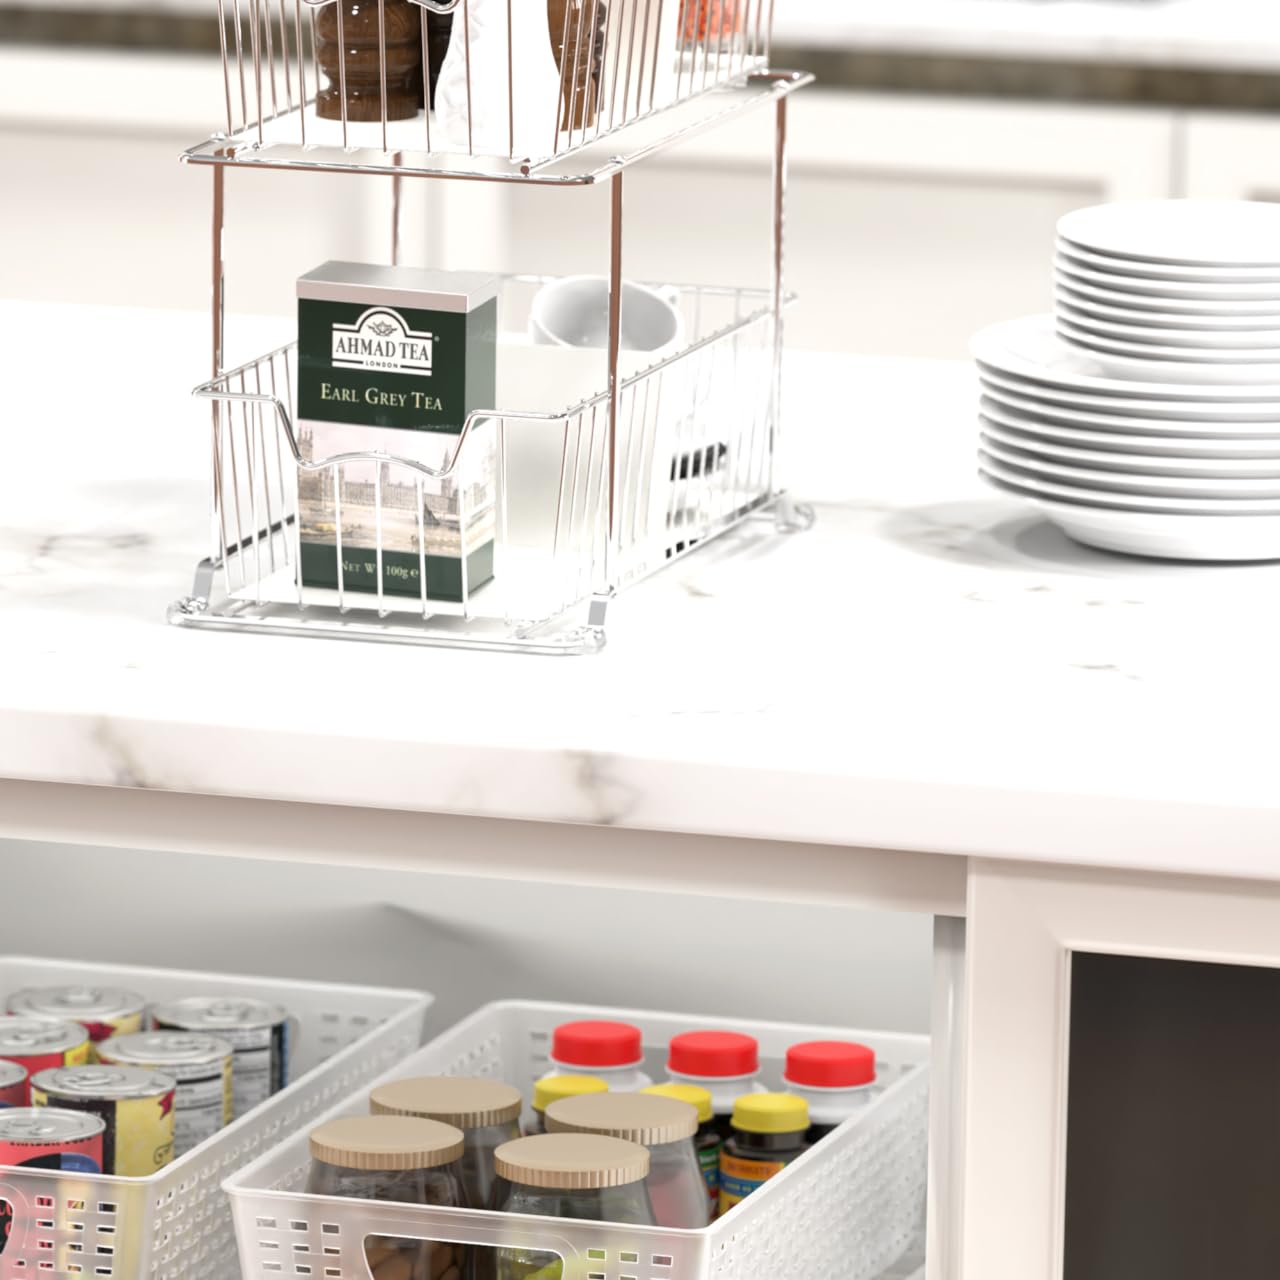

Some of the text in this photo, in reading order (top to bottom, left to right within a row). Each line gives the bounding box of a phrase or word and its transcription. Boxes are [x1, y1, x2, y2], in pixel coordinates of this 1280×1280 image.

[336, 336, 429, 361] AHMAD TEA
[365, 360, 399, 369] LONDON
[321, 383, 443, 411] EARL GREY TEA
[386, 564, 409, 579] 100g
